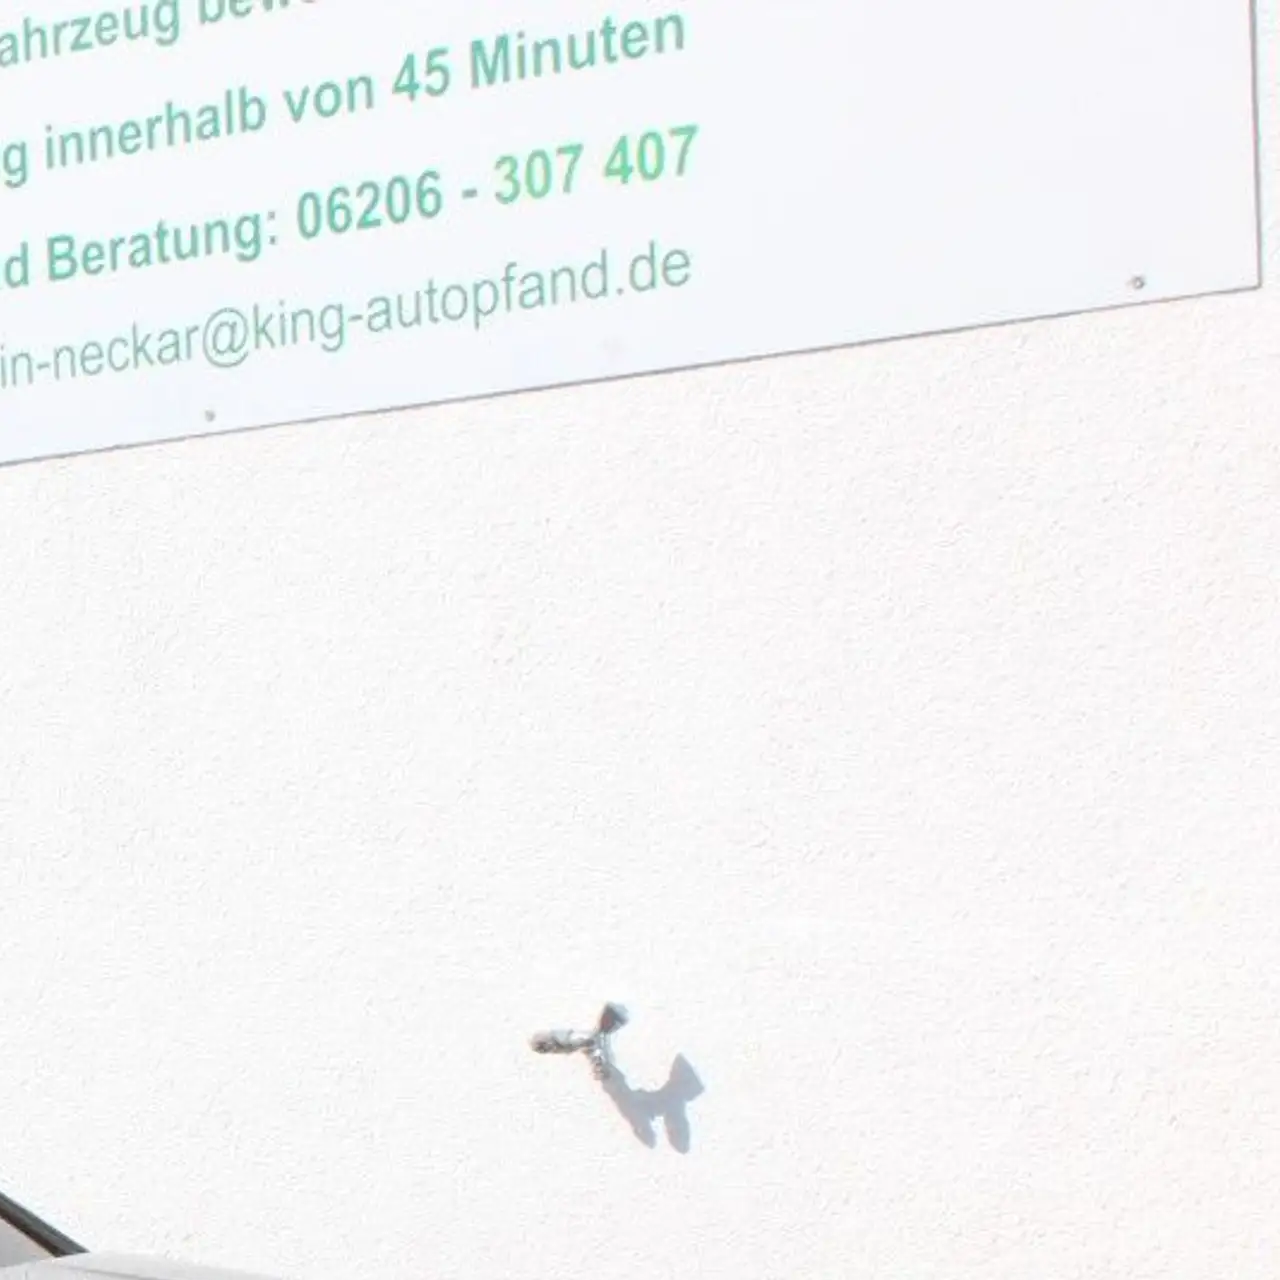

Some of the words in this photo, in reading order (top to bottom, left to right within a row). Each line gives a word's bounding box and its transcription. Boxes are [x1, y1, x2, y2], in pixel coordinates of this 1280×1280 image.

[44, 85, 269, 171] innerhalb
[283, 74, 377, 124] von
[391, 45, 454, 103] 45
[469, 11, 687, 90] Minuten
[46, 209, 278, 283] Beratung:
[296, 166, 445, 242] 06206
[493, 140, 585, 206] 307
[603, 122, 701, 186] 407
